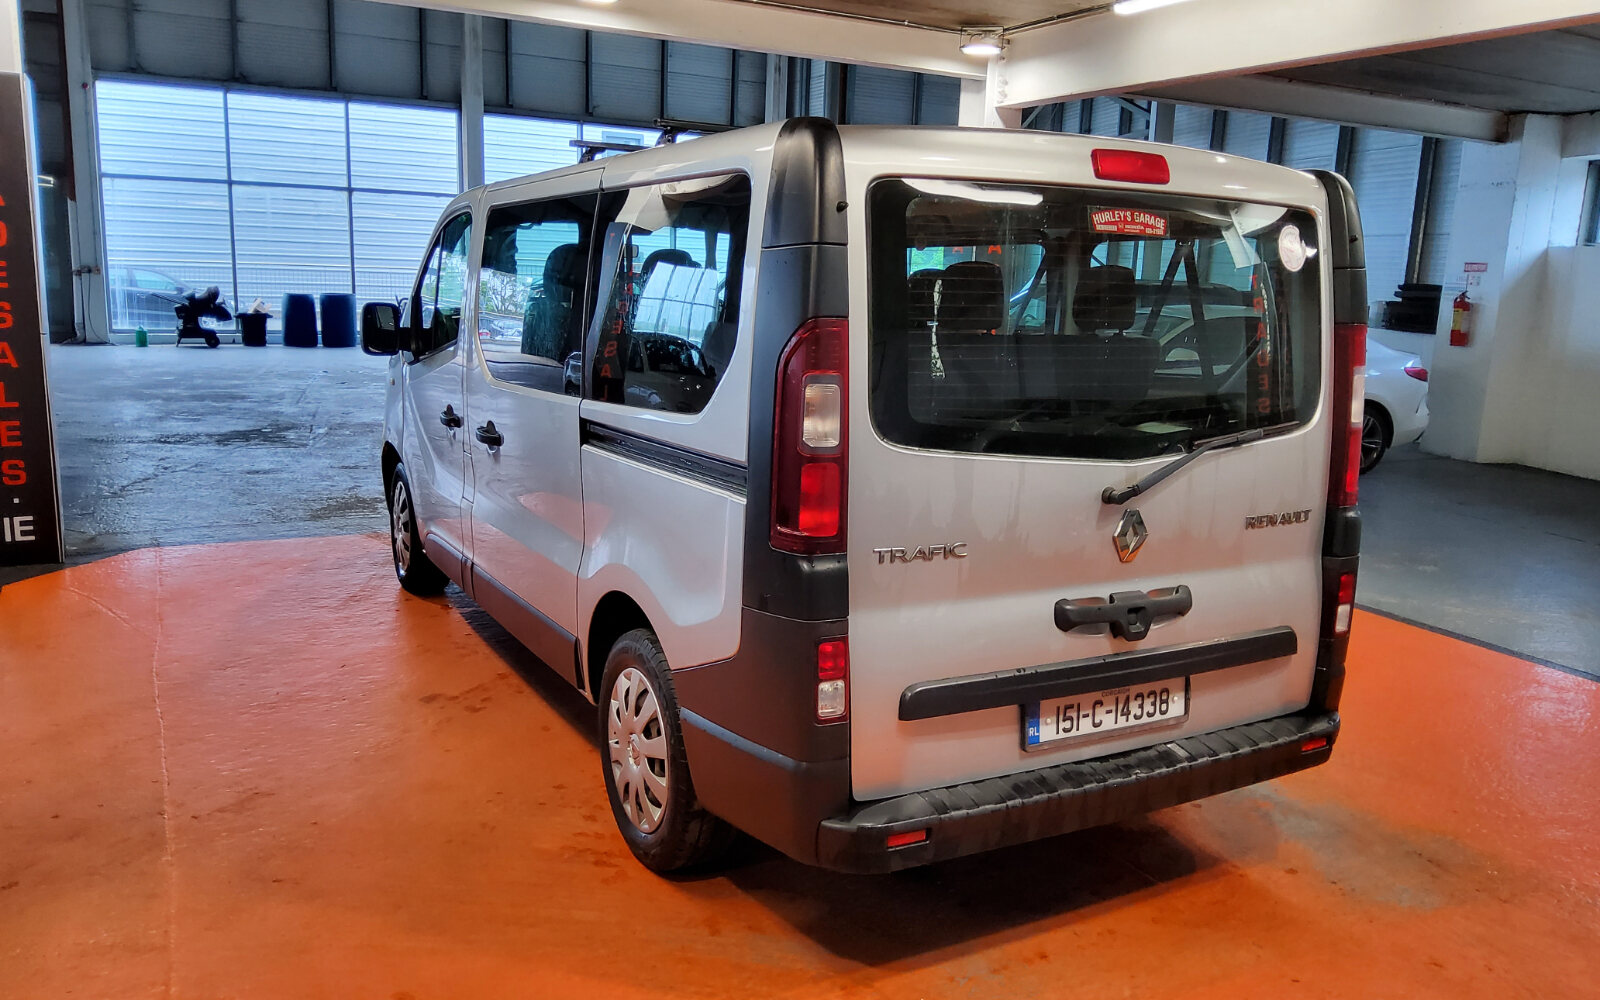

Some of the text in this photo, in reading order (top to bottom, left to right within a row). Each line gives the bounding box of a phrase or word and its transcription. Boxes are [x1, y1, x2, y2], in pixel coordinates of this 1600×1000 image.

[1092, 210, 1132, 225] HURLEY'S
[1133, 212, 1166, 230] GARAGE
[1245, 508, 1312, 530] RENAULT
[872, 541, 968, 565] TRAFIC
[1055, 688, 1170, 735] 151-C-14338
